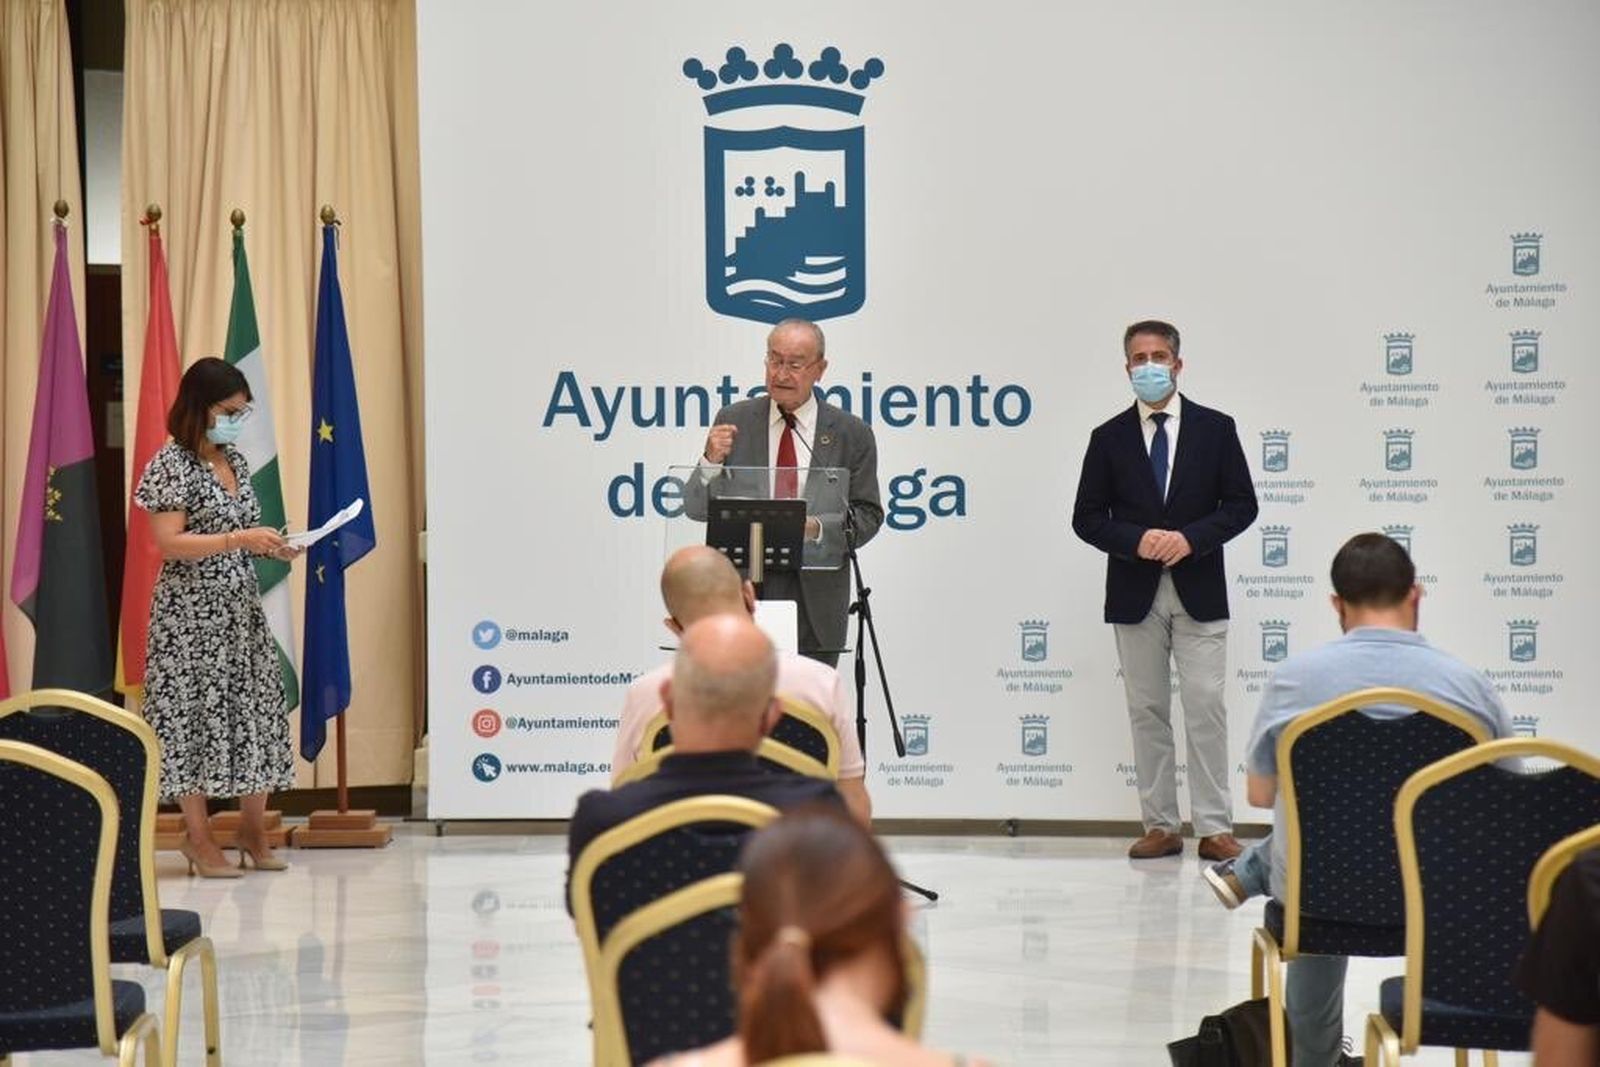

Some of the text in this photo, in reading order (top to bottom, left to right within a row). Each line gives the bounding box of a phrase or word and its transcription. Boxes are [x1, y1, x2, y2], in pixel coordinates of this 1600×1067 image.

[1485, 283, 1568, 296] Ayuntamiento
[1495, 298, 1510, 308] de
[1360, 382, 1440, 394] Ayuntamiento
[1485, 379, 1567, 392] Ayuntamiento
[1370, 397, 1384, 406] de
[1495, 395, 1509, 405] de
[542, 371, 1032, 441] Ayuntiento
[1253, 480, 1315, 489] untamiento
[1359, 478, 1438, 490] Ayuntamiento
[1484, 477, 1565, 489] Ayuntamiento
[607, 462, 686, 518] de
[1369, 493, 1383, 502] de
[1494, 492, 1508, 500] de
[1236, 574, 1314, 585] Ayuntamiento
[1483, 573, 1563, 585] Ayuntamiento
[1246, 589, 1260, 598] de
[1493, 587, 1508, 597] de
[505, 629, 569, 643] @malaga
[996, 668, 1075, 680] Ayuntamiento
[506, 673, 643, 687] AyuntamientodeM
[1006, 683, 1020, 692] de
[878, 762, 954, 773] Ayuntamiento
[997, 763, 1075, 774] Ayuntamiento
[887, 776, 902, 786] de
[1006, 778, 1020, 786] de
